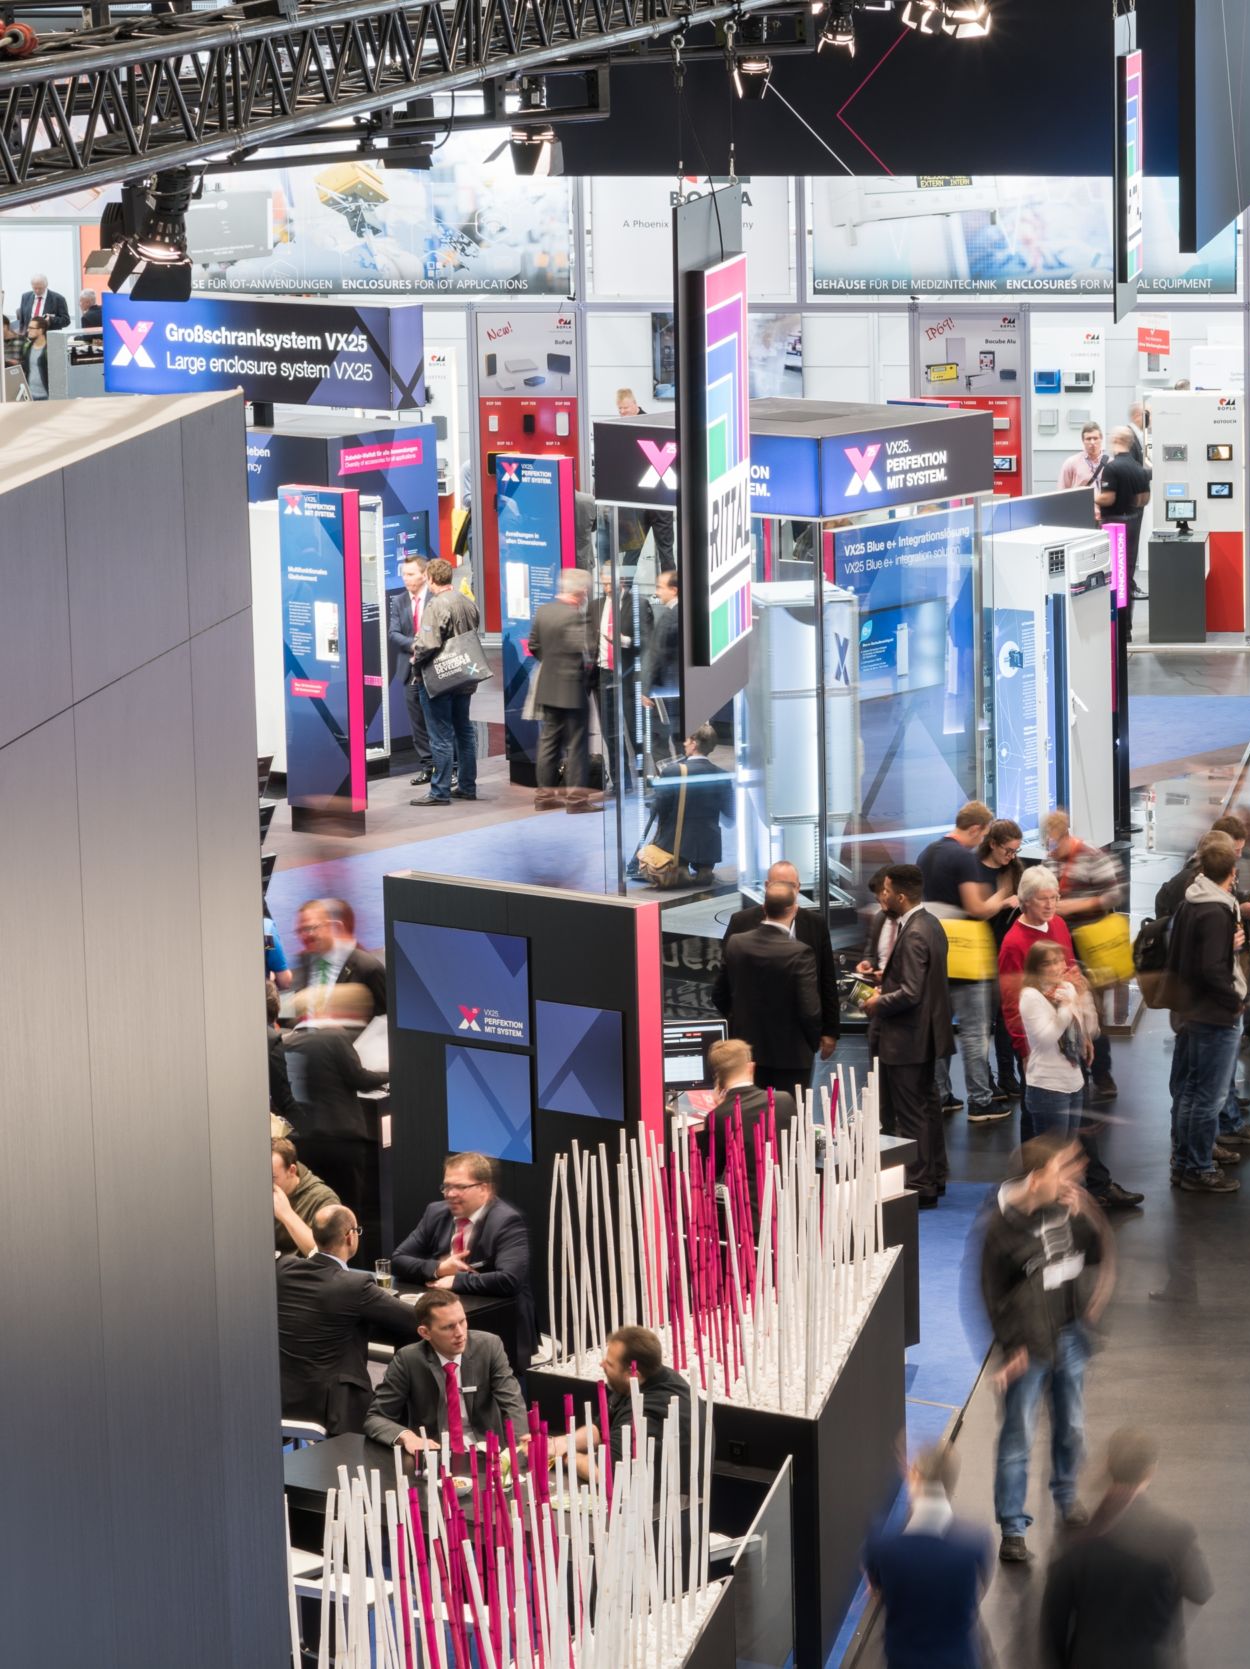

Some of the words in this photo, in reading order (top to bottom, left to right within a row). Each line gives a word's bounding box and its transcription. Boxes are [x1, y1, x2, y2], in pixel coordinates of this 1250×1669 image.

[622, 220, 630, 228] A
[632, 220, 669, 228] Phoenix
[208, 278, 228, 290] FÜR
[229, 279, 333, 290] IOT-ANWENDUNGEN
[342, 279, 412, 290] ENCLOSURES
[414, 279, 435, 290] FOR
[436, 279, 453, 290] IOT
[456, 279, 528, 290] APPLICATIONS
[814, 276, 866, 290] GEHÄUSE
[869, 276, 889, 290] FÜR
[891, 279, 908, 290] DIE
[910, 279, 997, 290] MEDIZINTECHNIK
[1006, 279, 1078, 290] ENCLOSURES
[1080, 279, 1100, 290] FOR
[1152, 278, 1213, 291] EQUIPMENT
[165, 323, 321, 352] Großschranksystem
[325, 332, 368, 353] VX25
[486, 320, 513, 342] New!
[925, 317, 955, 342] IP69!
[166, 351, 206, 375] Large
[210, 355, 278, 376] enclosure
[280, 360, 331, 382] system
[334, 361, 374, 382] VX25
[886, 440, 912, 456] VX25.
[886, 450, 948, 472] PERFEKTION
[522, 470, 552, 478] PERFEKTION
[886, 474, 905, 490] MIT
[906, 468, 948, 488] SYSTEM.
[304, 503, 336, 512] PERFEKTION
[710, 478, 750, 573] RITTAL
[844, 540, 866, 556] VX25
[866, 538, 885, 552] Blue
[886, 537, 898, 550] e+
[898, 526, 970, 548] Integrationslösung
[844, 560, 865, 574] VX25
[866, 556, 883, 572] Blue
[884, 556, 894, 569] e+
[895, 550, 932, 566] integration
[933, 544, 960, 560] solution
[484, 1008, 500, 1017] VX25.
[484, 1017, 524, 1029] PERFEKTION
[496, 1027, 524, 1038] SYSTEM.
